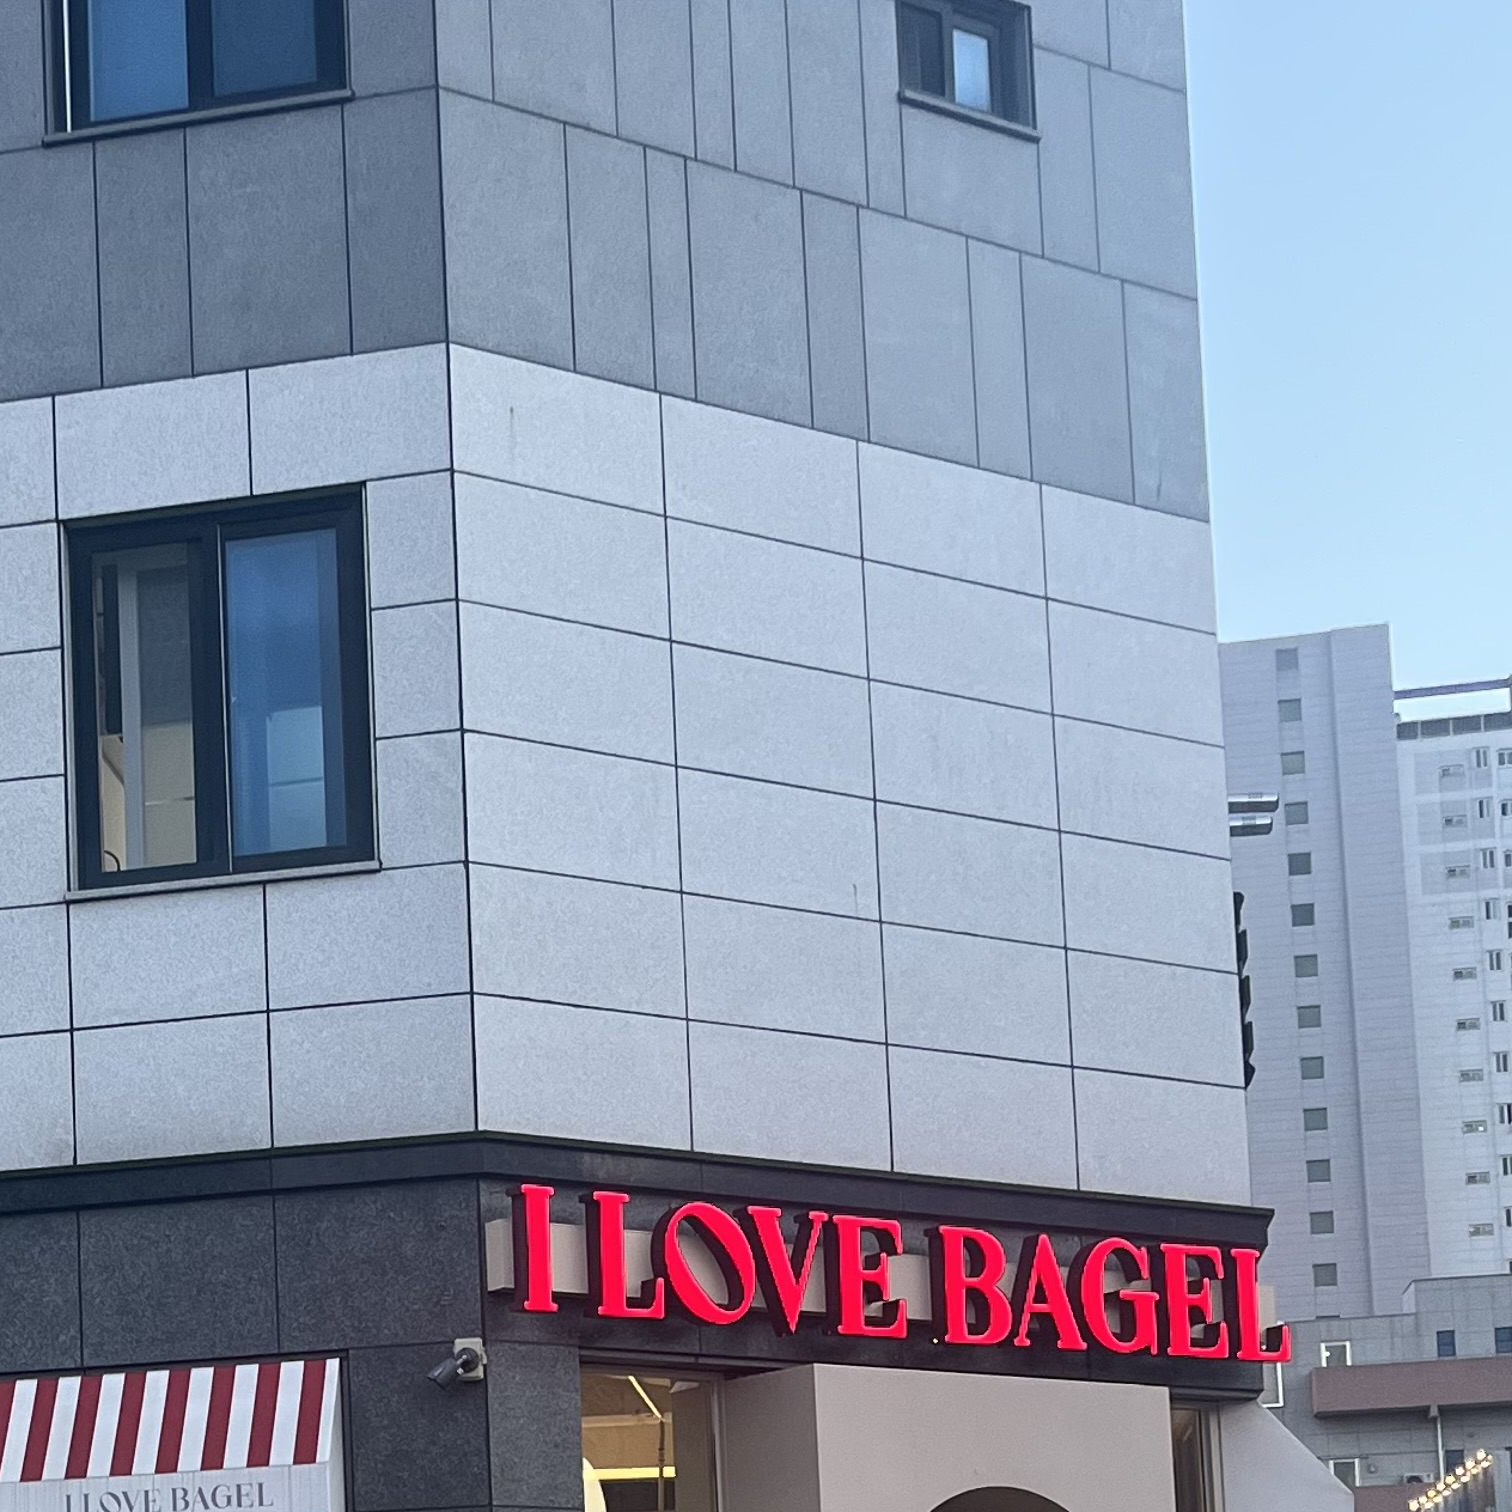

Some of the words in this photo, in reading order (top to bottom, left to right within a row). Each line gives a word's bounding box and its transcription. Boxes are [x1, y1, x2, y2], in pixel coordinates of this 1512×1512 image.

[521, 1184, 558, 1312] I
[593, 1191, 908, 1338] LOVE
[939, 1225, 1291, 1362] BAGEL
[171, 1482, 274, 1512] BAGEL
